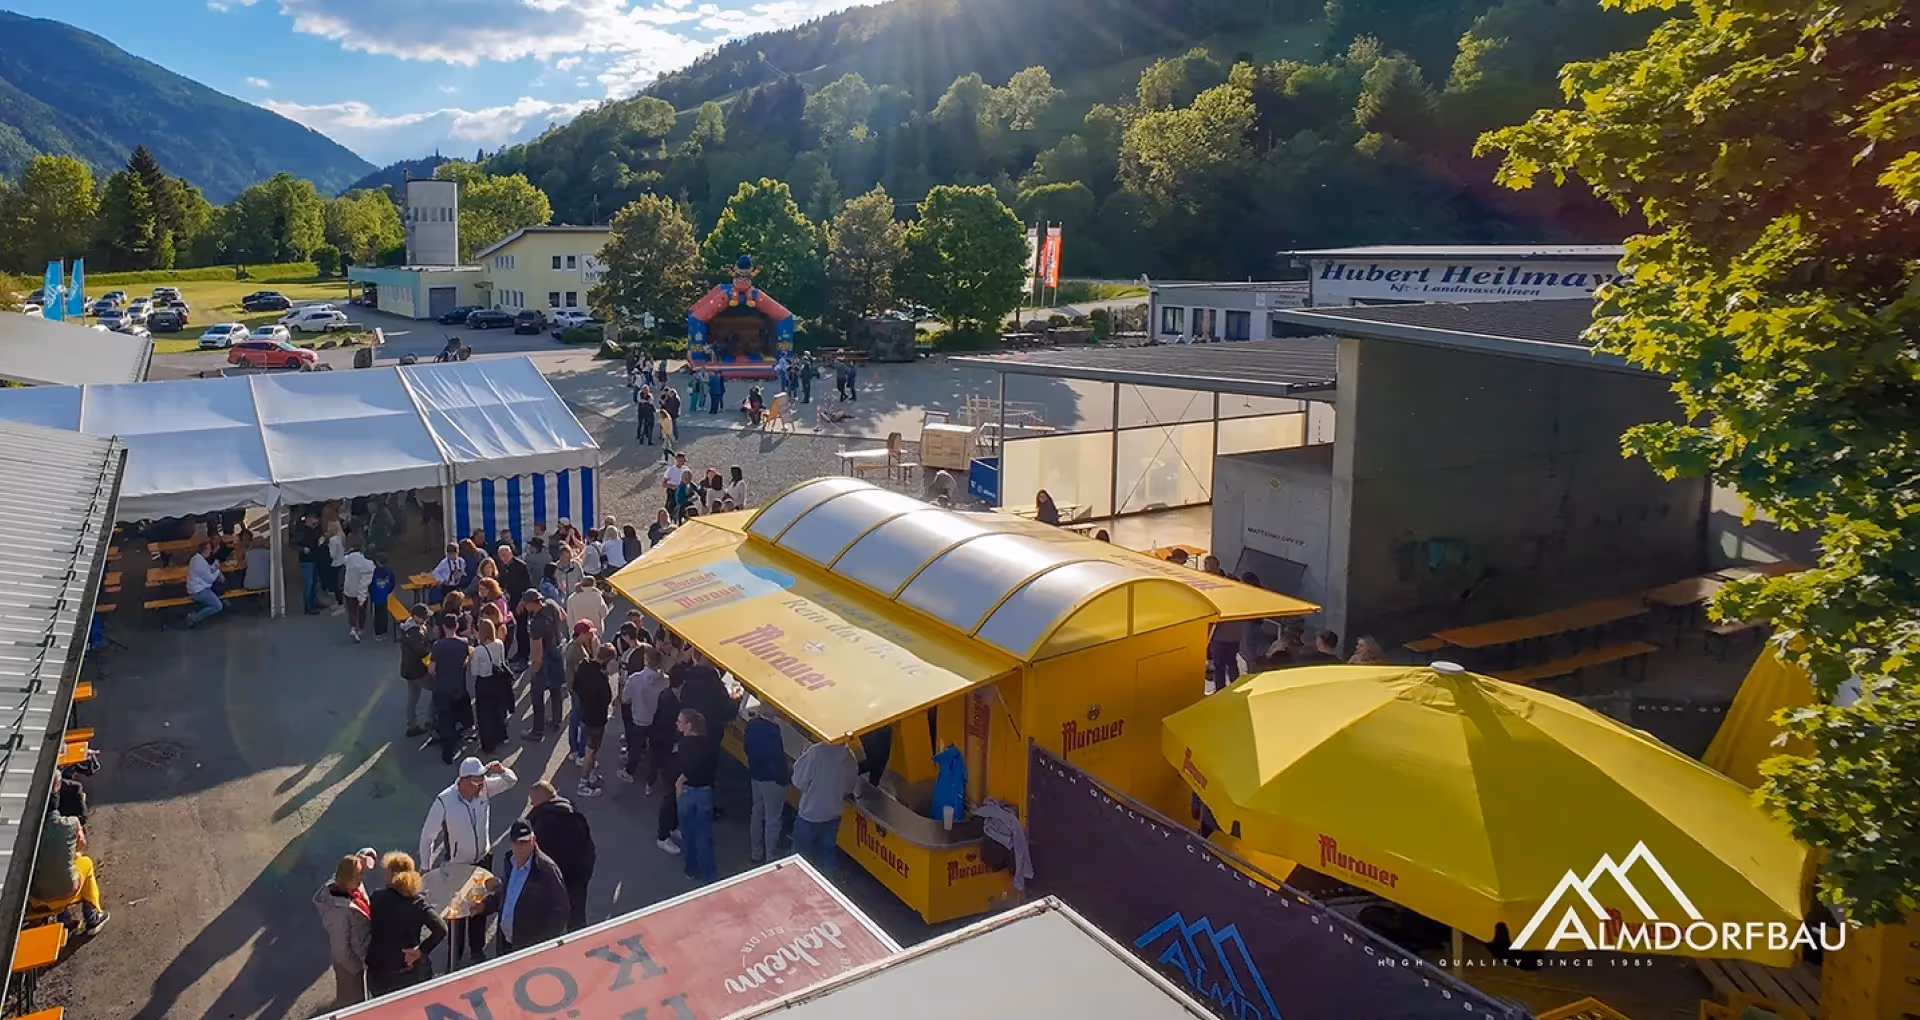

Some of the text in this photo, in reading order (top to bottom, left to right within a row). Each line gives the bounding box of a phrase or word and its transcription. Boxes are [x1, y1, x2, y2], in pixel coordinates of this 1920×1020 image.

[1319, 263, 1635, 294] Hubert Heilmaye
[1423, 284, 1541, 296] Landmaschinen
[674, 583, 745, 608] Murauer
[719, 623, 836, 692] Murauer
[1062, 718, 1125, 761] Murauer
[1089, 787, 1171, 839] QUALITY
[855, 811, 911, 880] Murauer
[1318, 833, 1399, 889] Murauer
[723, 921, 848, 996] daheim
